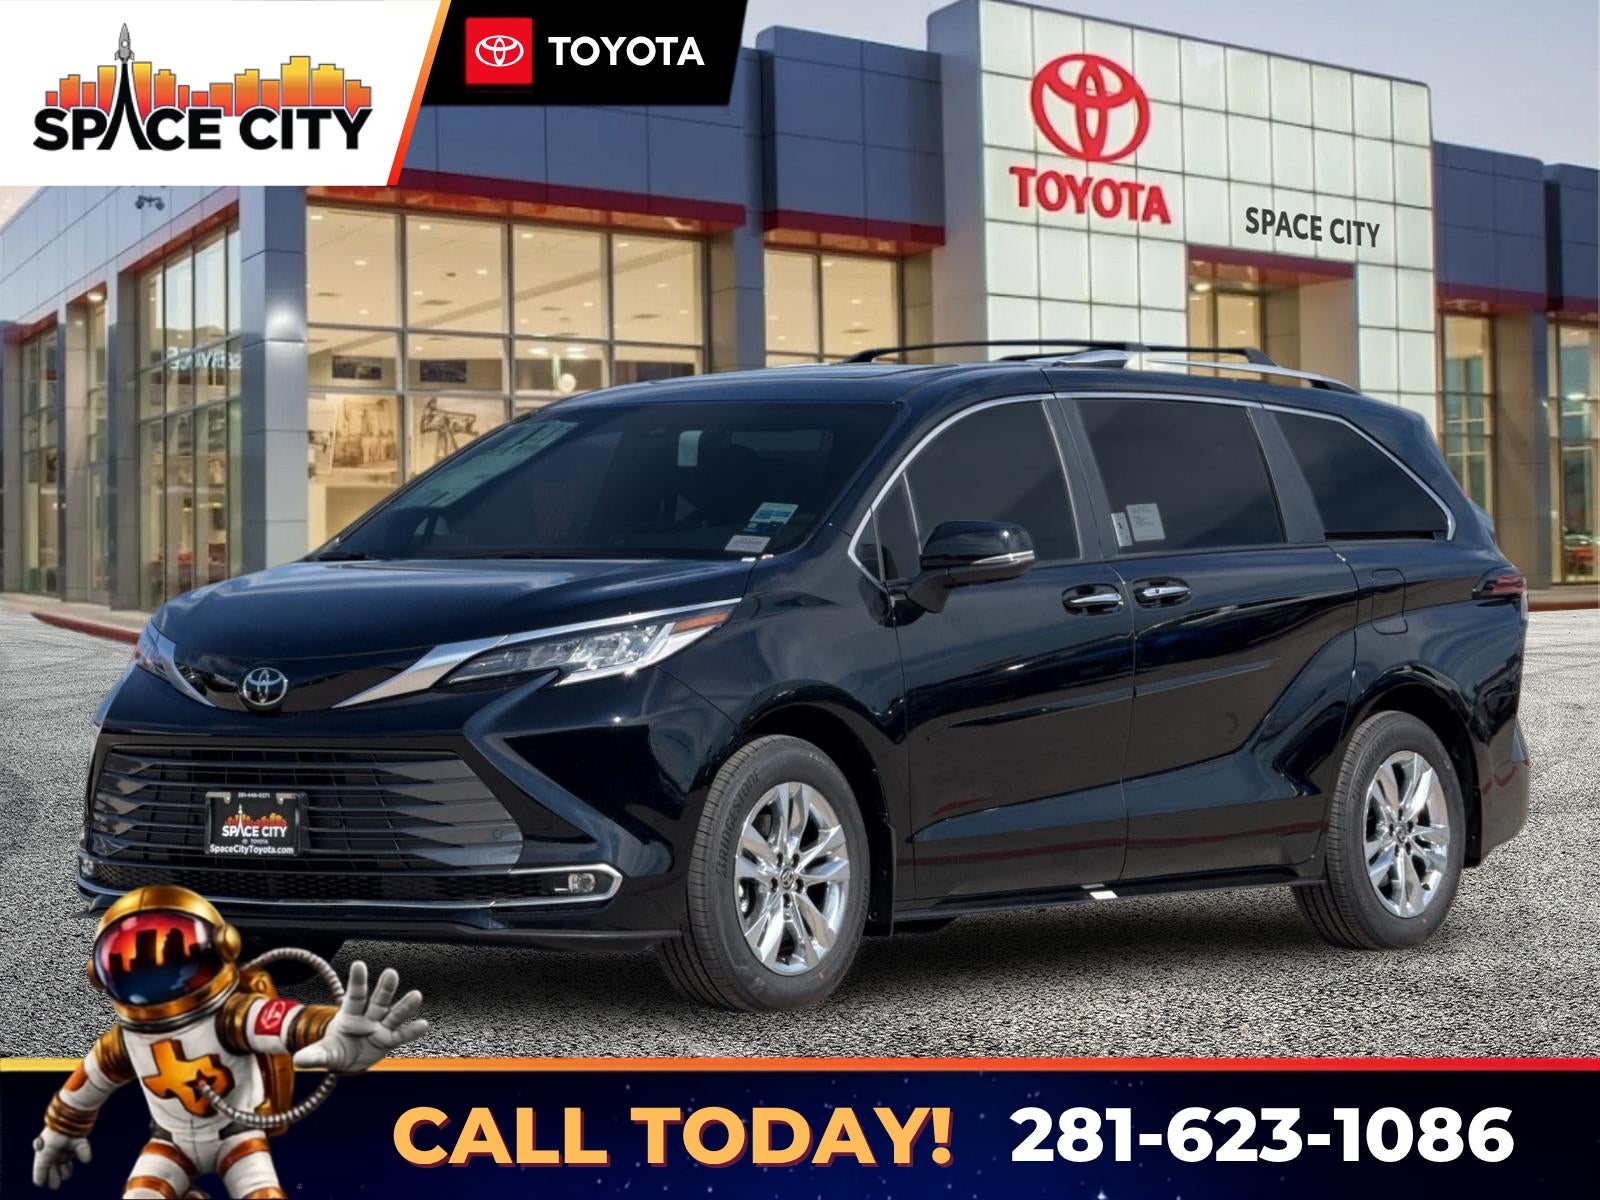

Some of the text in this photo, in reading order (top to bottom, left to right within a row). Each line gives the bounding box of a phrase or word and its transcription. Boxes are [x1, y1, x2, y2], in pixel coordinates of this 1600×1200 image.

[1009, 166, 1172, 225] TOYOTA
[1244, 206, 1381, 249] SPACE CITY
[222, 823, 287, 837] SPACE CITY
[210, 844, 294, 855] SpaceCityToyota.com
